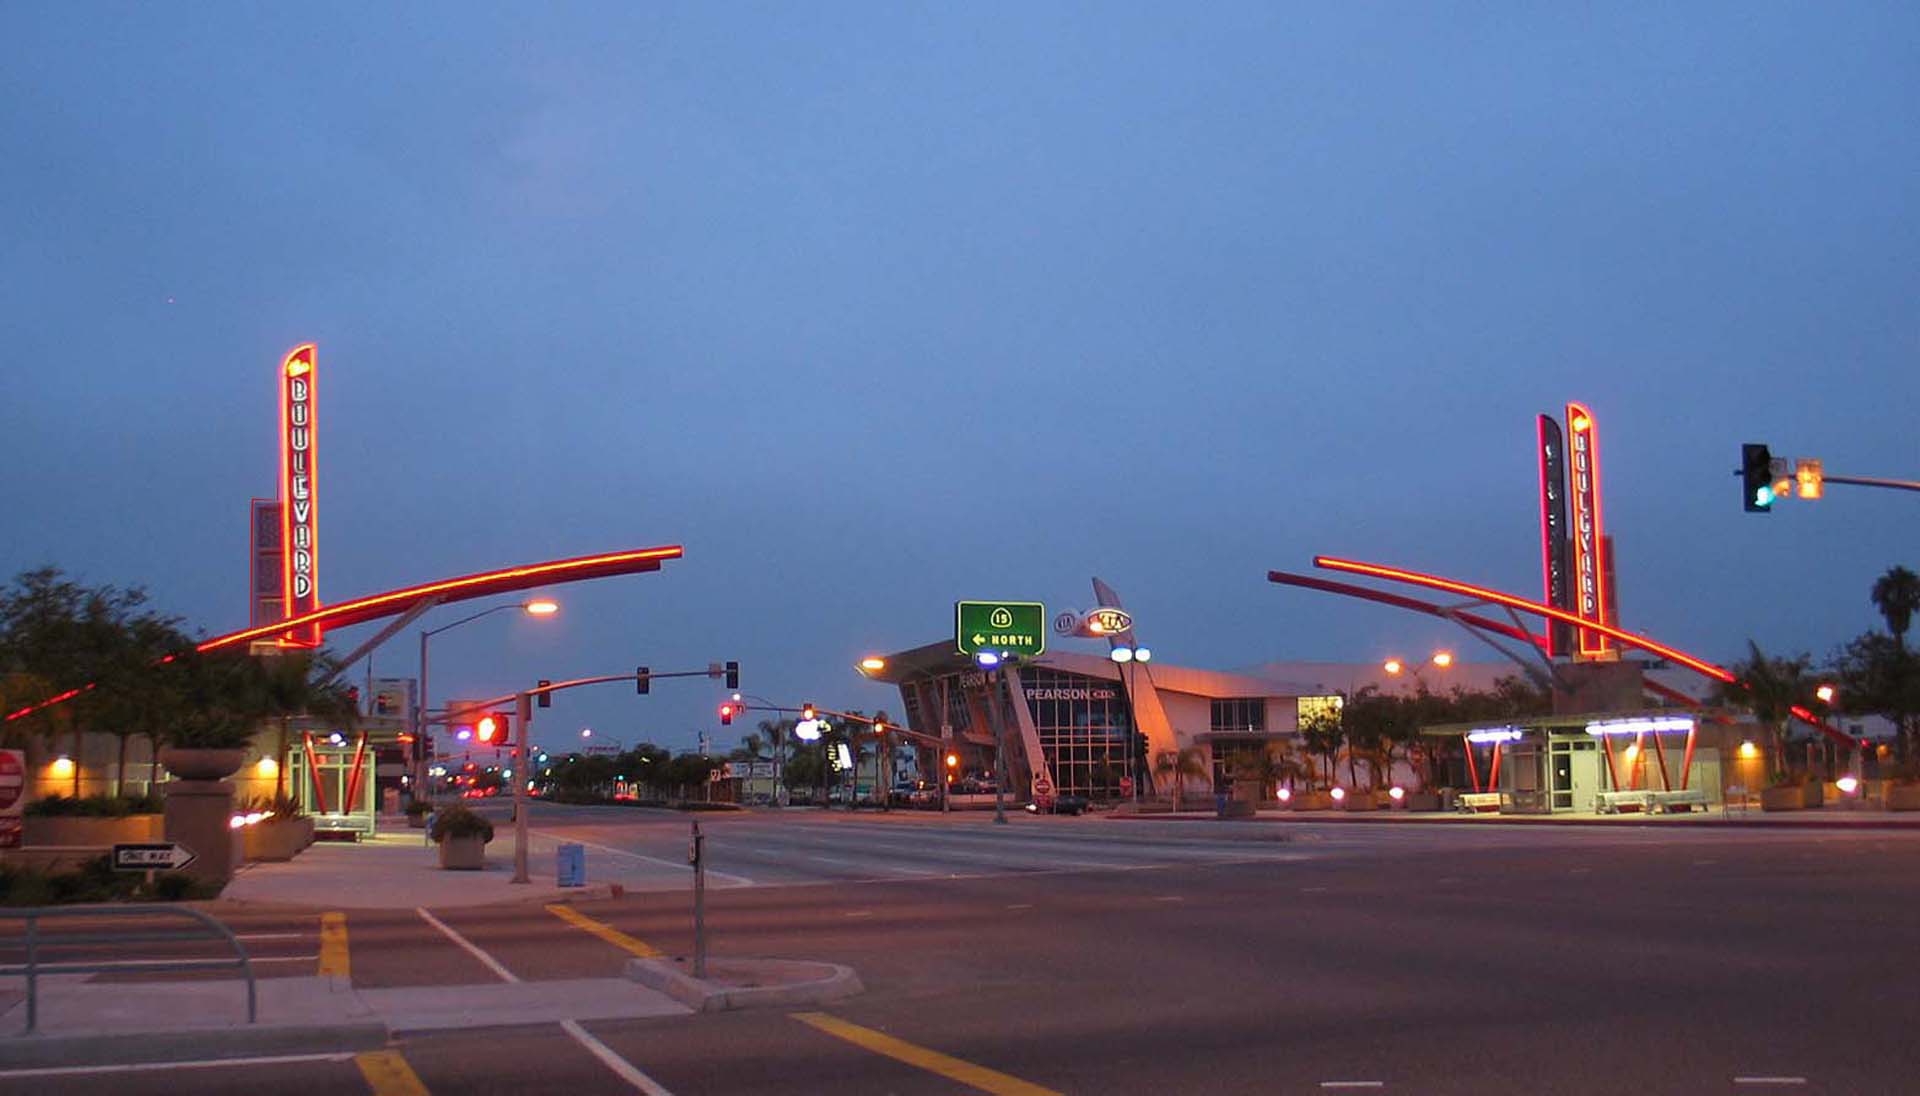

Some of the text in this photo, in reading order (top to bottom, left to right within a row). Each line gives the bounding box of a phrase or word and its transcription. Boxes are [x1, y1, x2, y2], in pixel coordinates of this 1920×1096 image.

[291, 378, 311, 597] BOULEVARD
[995, 614, 1008, 623] 15
[991, 635, 1033, 646] NORTH
[1026, 689, 1090, 700] PEARSON
